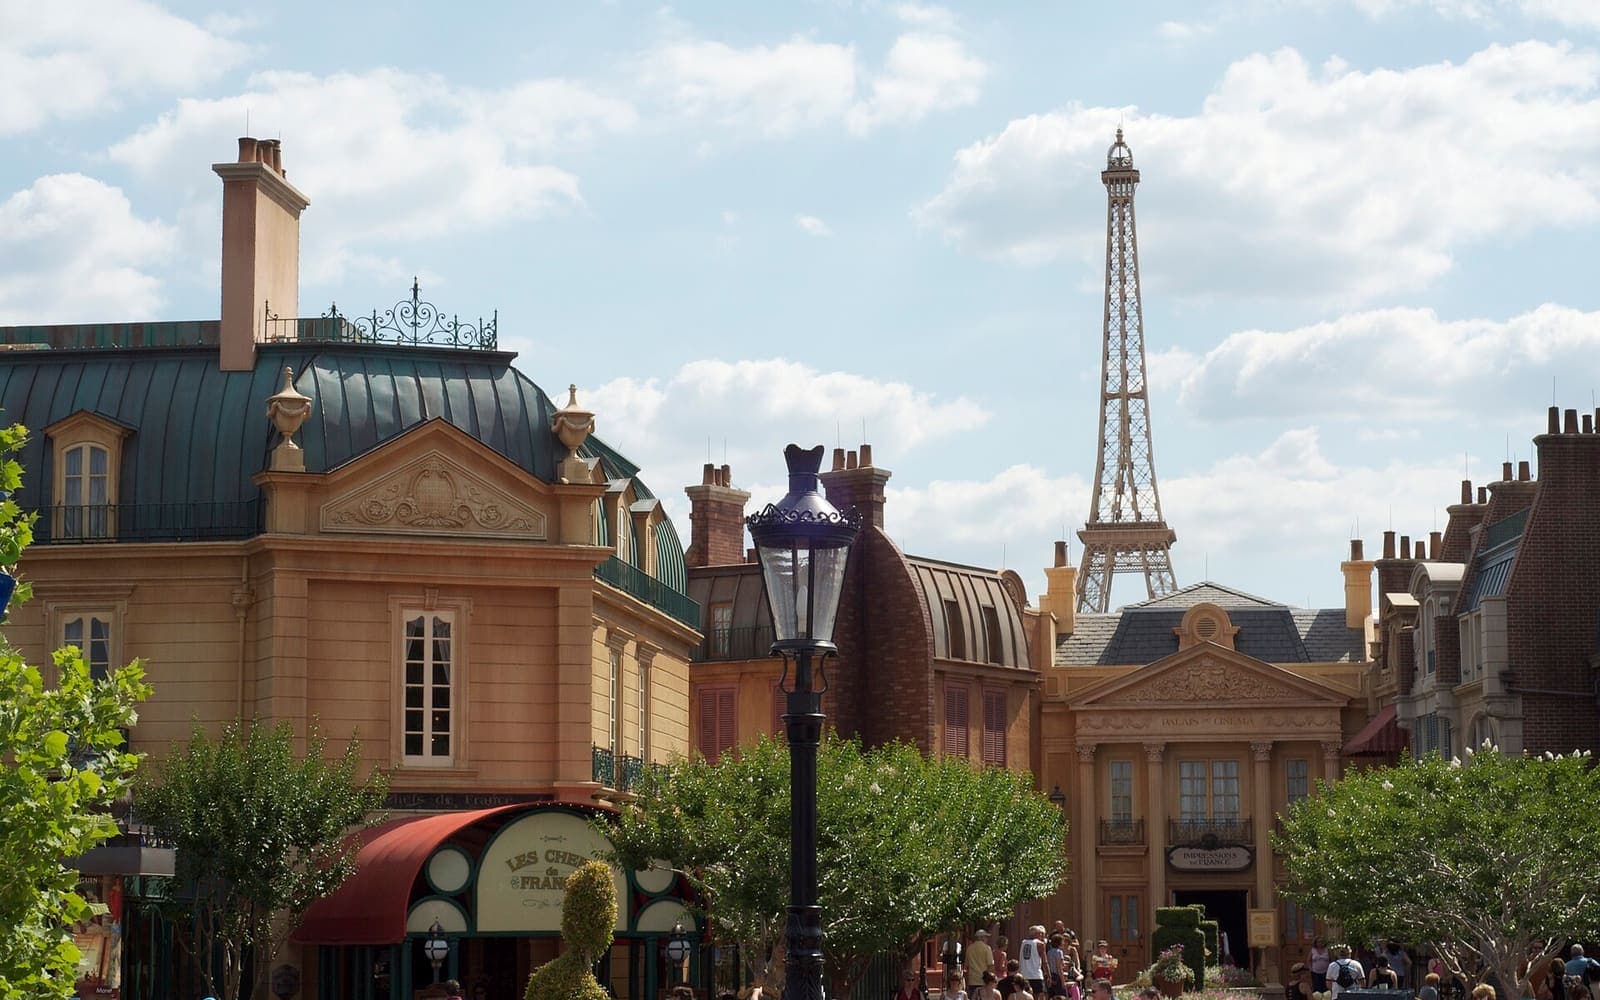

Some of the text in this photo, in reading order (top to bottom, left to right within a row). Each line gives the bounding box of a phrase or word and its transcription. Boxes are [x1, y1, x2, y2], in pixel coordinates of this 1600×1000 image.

[505, 849, 586, 873] LES CHEF
[545, 866, 559, 876] de
[520, 876, 566, 890] FRAN
